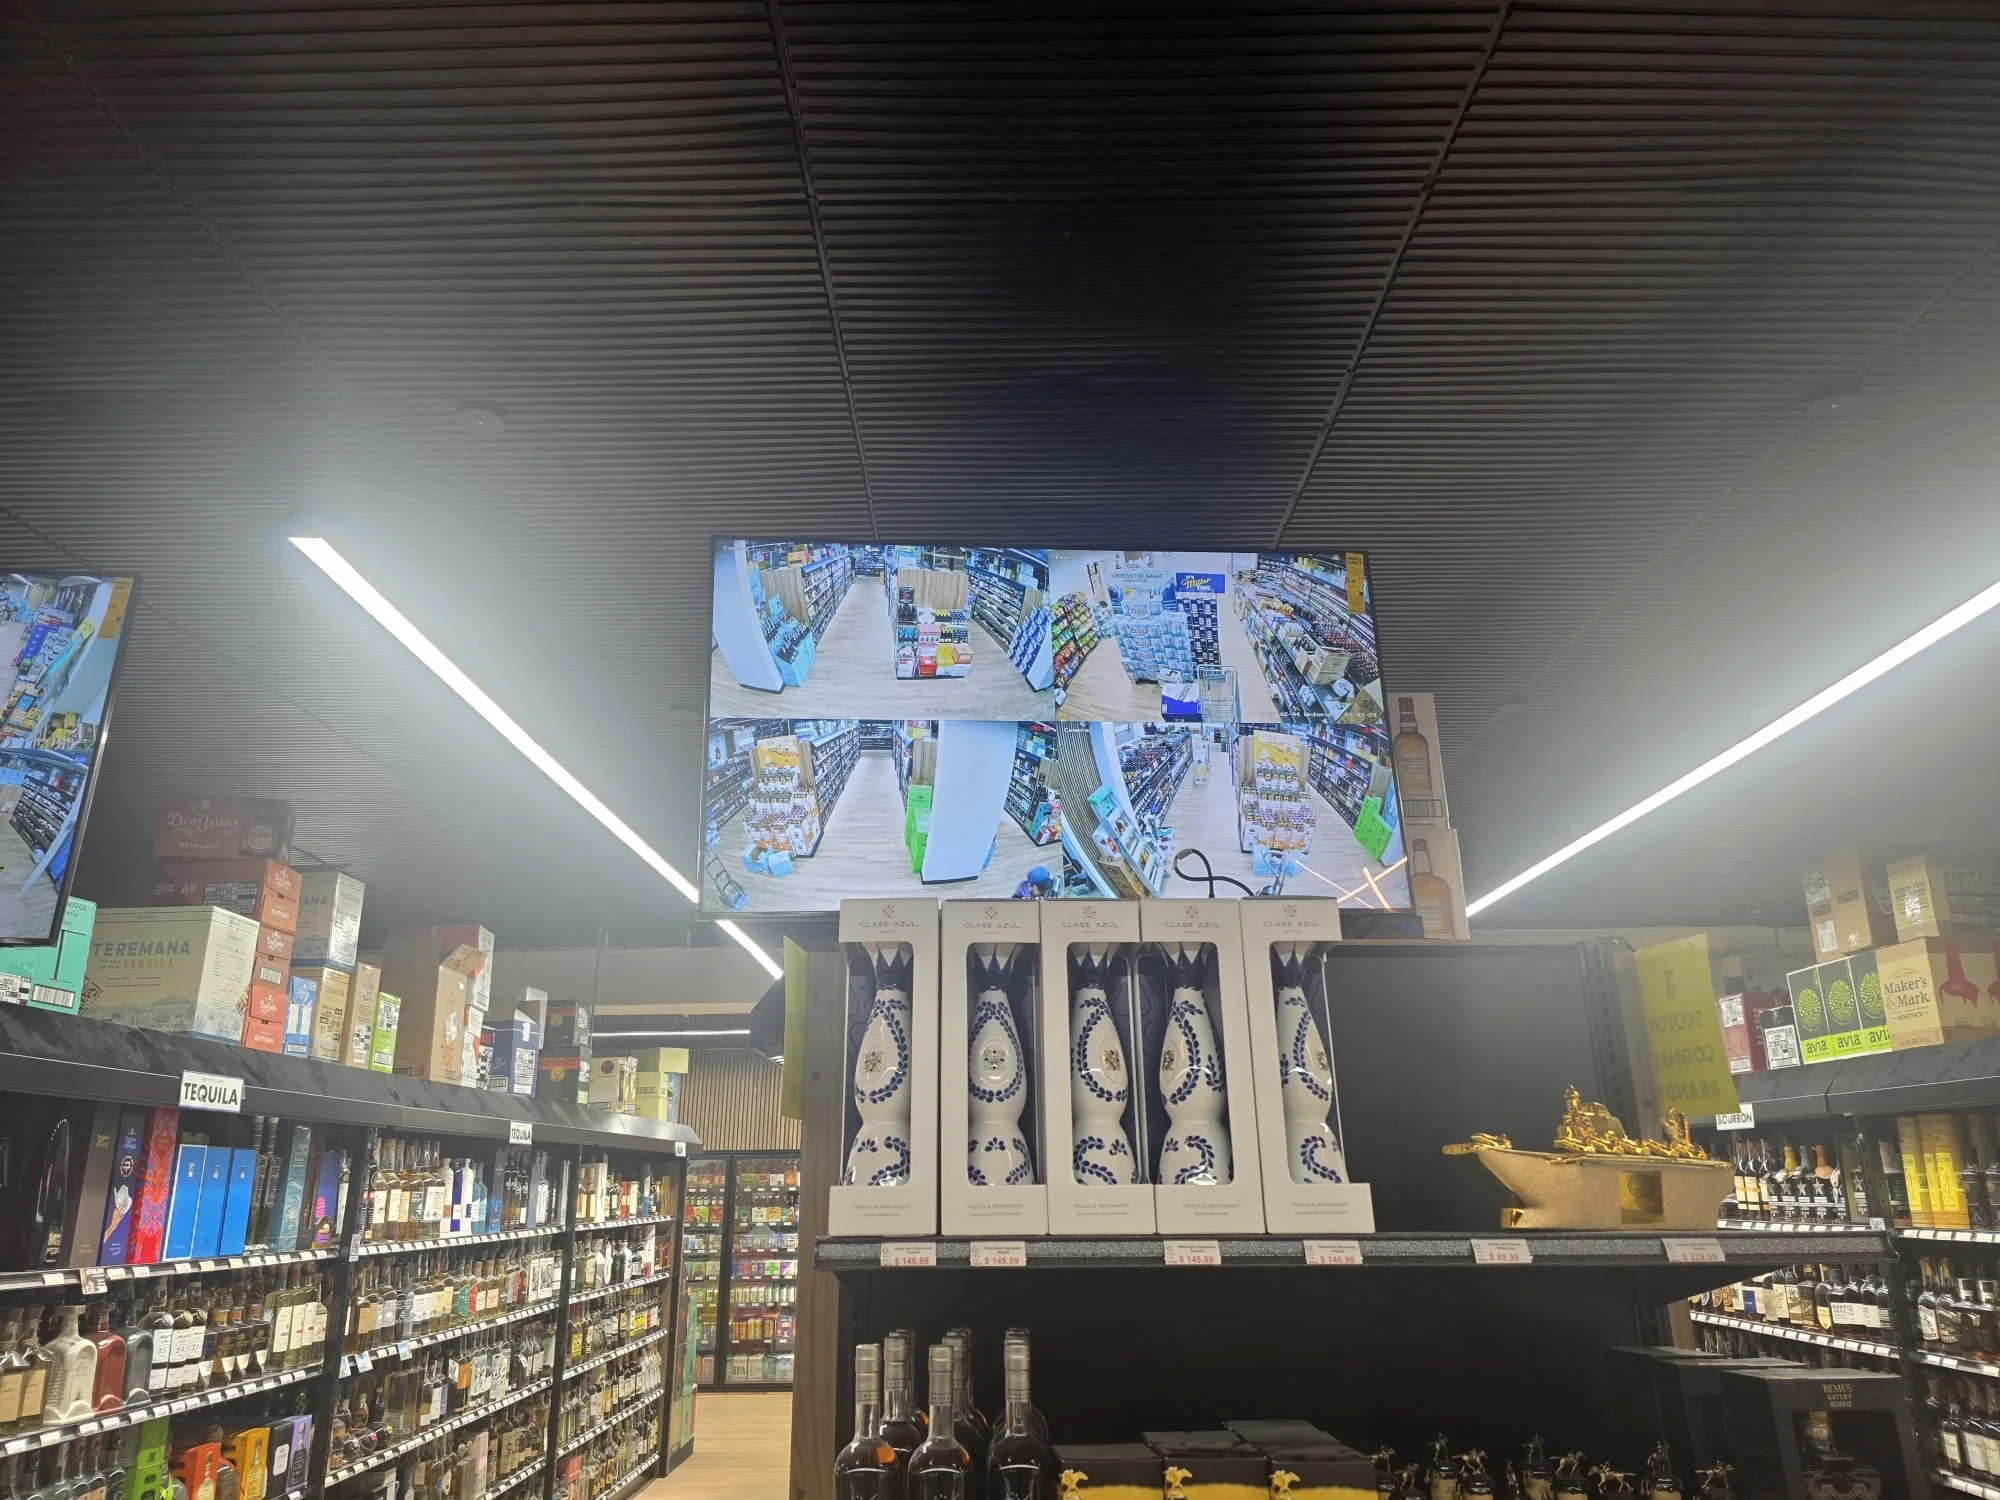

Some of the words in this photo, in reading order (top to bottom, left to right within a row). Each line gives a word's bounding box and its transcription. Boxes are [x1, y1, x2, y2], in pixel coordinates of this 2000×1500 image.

[92, 940, 192, 957] TEREMANA
[123, 958, 174, 969] TEQUILA
[1883, 977, 1928, 995] Maker's
[1898, 990, 1930, 1008] Mark
[184, 1082, 238, 1105] TEQUILA
[1717, 1113, 1752, 1125] BOURBON
[511, 1127, 531, 1141] TEQUILA
[902, 1257, 929, 1265] 145.99
[1187, 1256, 1213, 1264] 145.99
[1328, 1256, 1355, 1264] 145.99
[1822, 1384, 1853, 1393] REMUS
